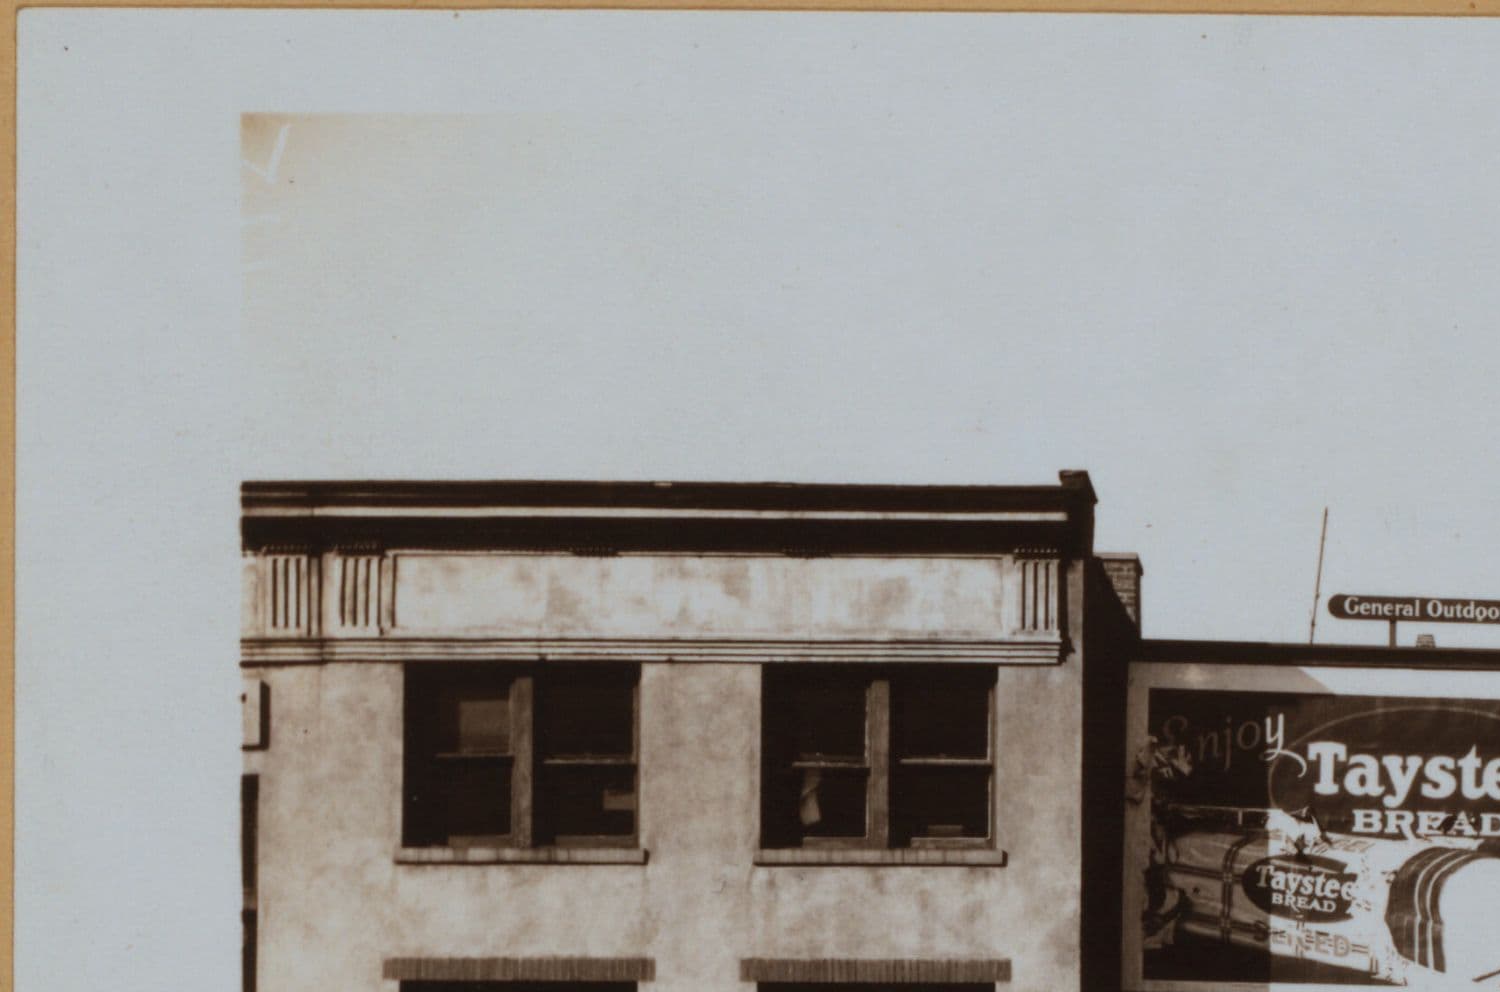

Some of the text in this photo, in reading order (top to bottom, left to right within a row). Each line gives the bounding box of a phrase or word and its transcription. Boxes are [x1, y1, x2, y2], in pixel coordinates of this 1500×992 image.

[1344, 597, 1419, 617] General
[1162, 712, 1308, 779] Enjoy
[1256, 865, 1357, 900] Taystee
[1272, 892, 1336, 913] BREAD
